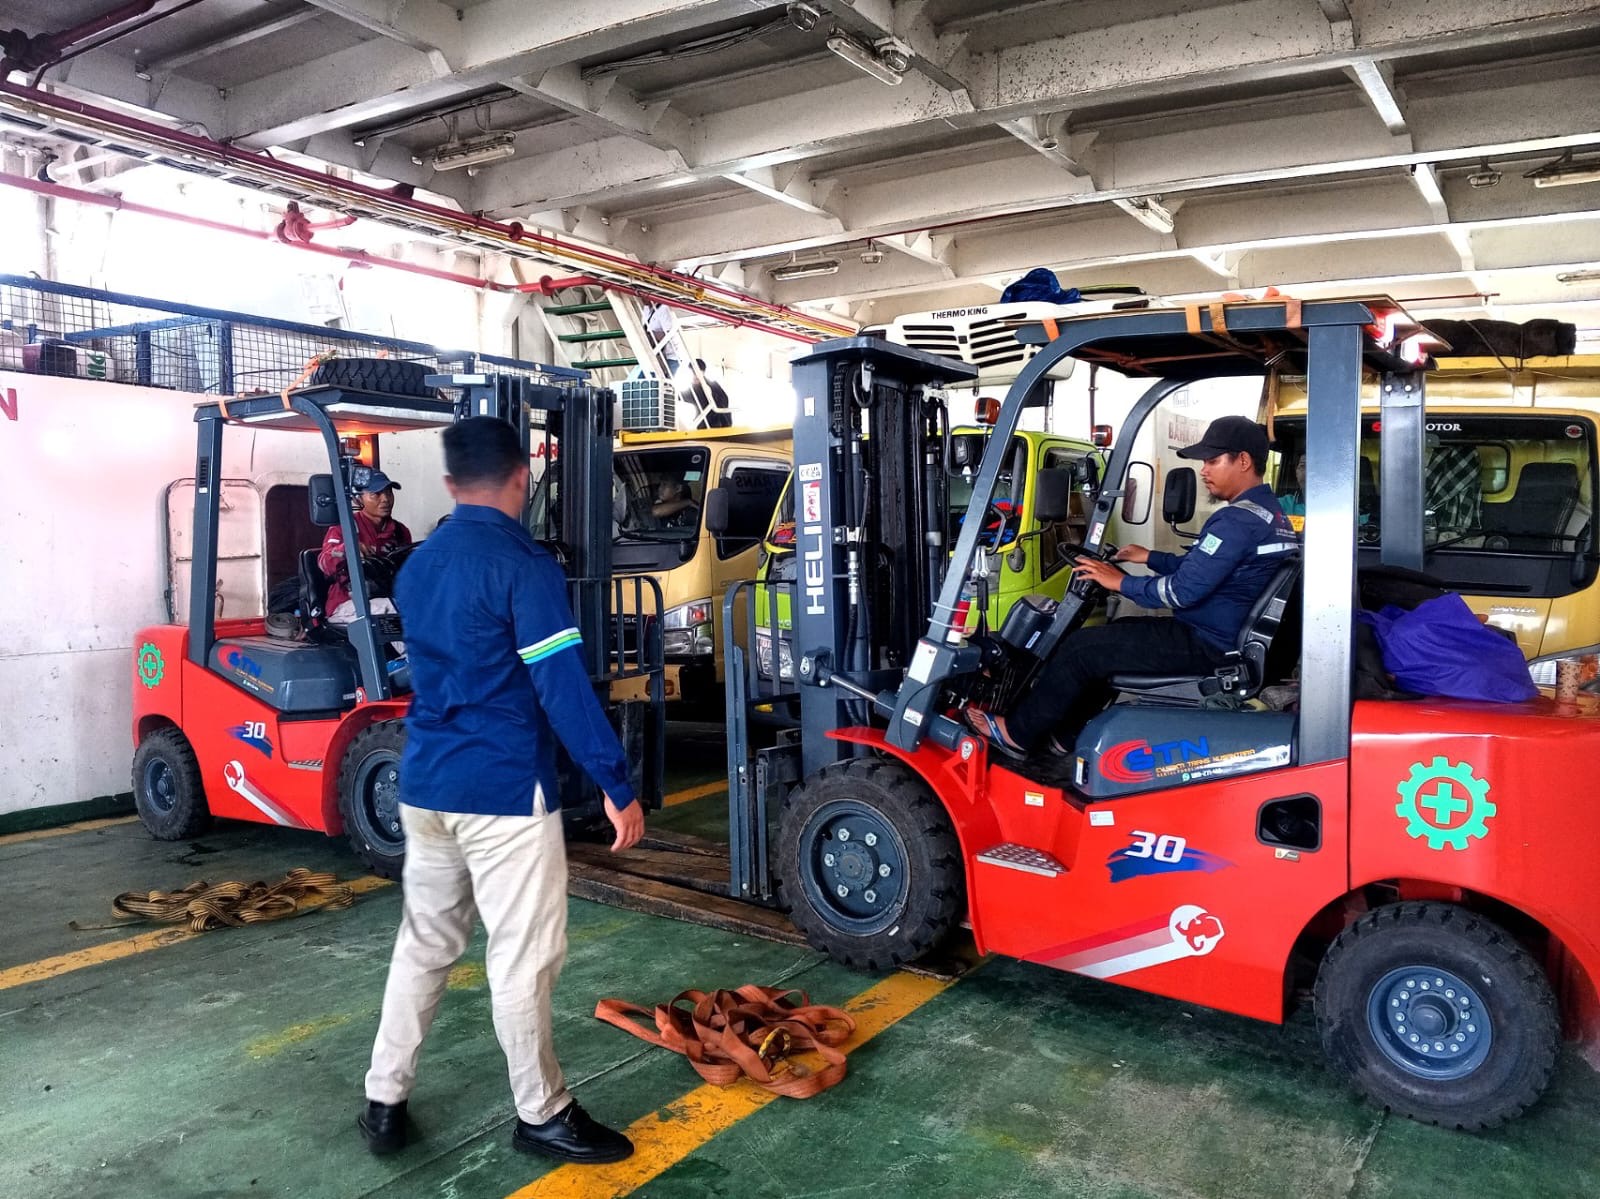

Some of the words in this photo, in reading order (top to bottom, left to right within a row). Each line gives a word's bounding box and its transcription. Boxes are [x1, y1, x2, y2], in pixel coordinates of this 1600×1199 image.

[931, 309, 966, 319] THERMO
[967, 307, 988, 316] KING
[1425, 423, 1462, 431] OTOR
[804, 525, 825, 615] HELI
[242, 720, 266, 739] 30
[1123, 830, 1187, 864] 30
